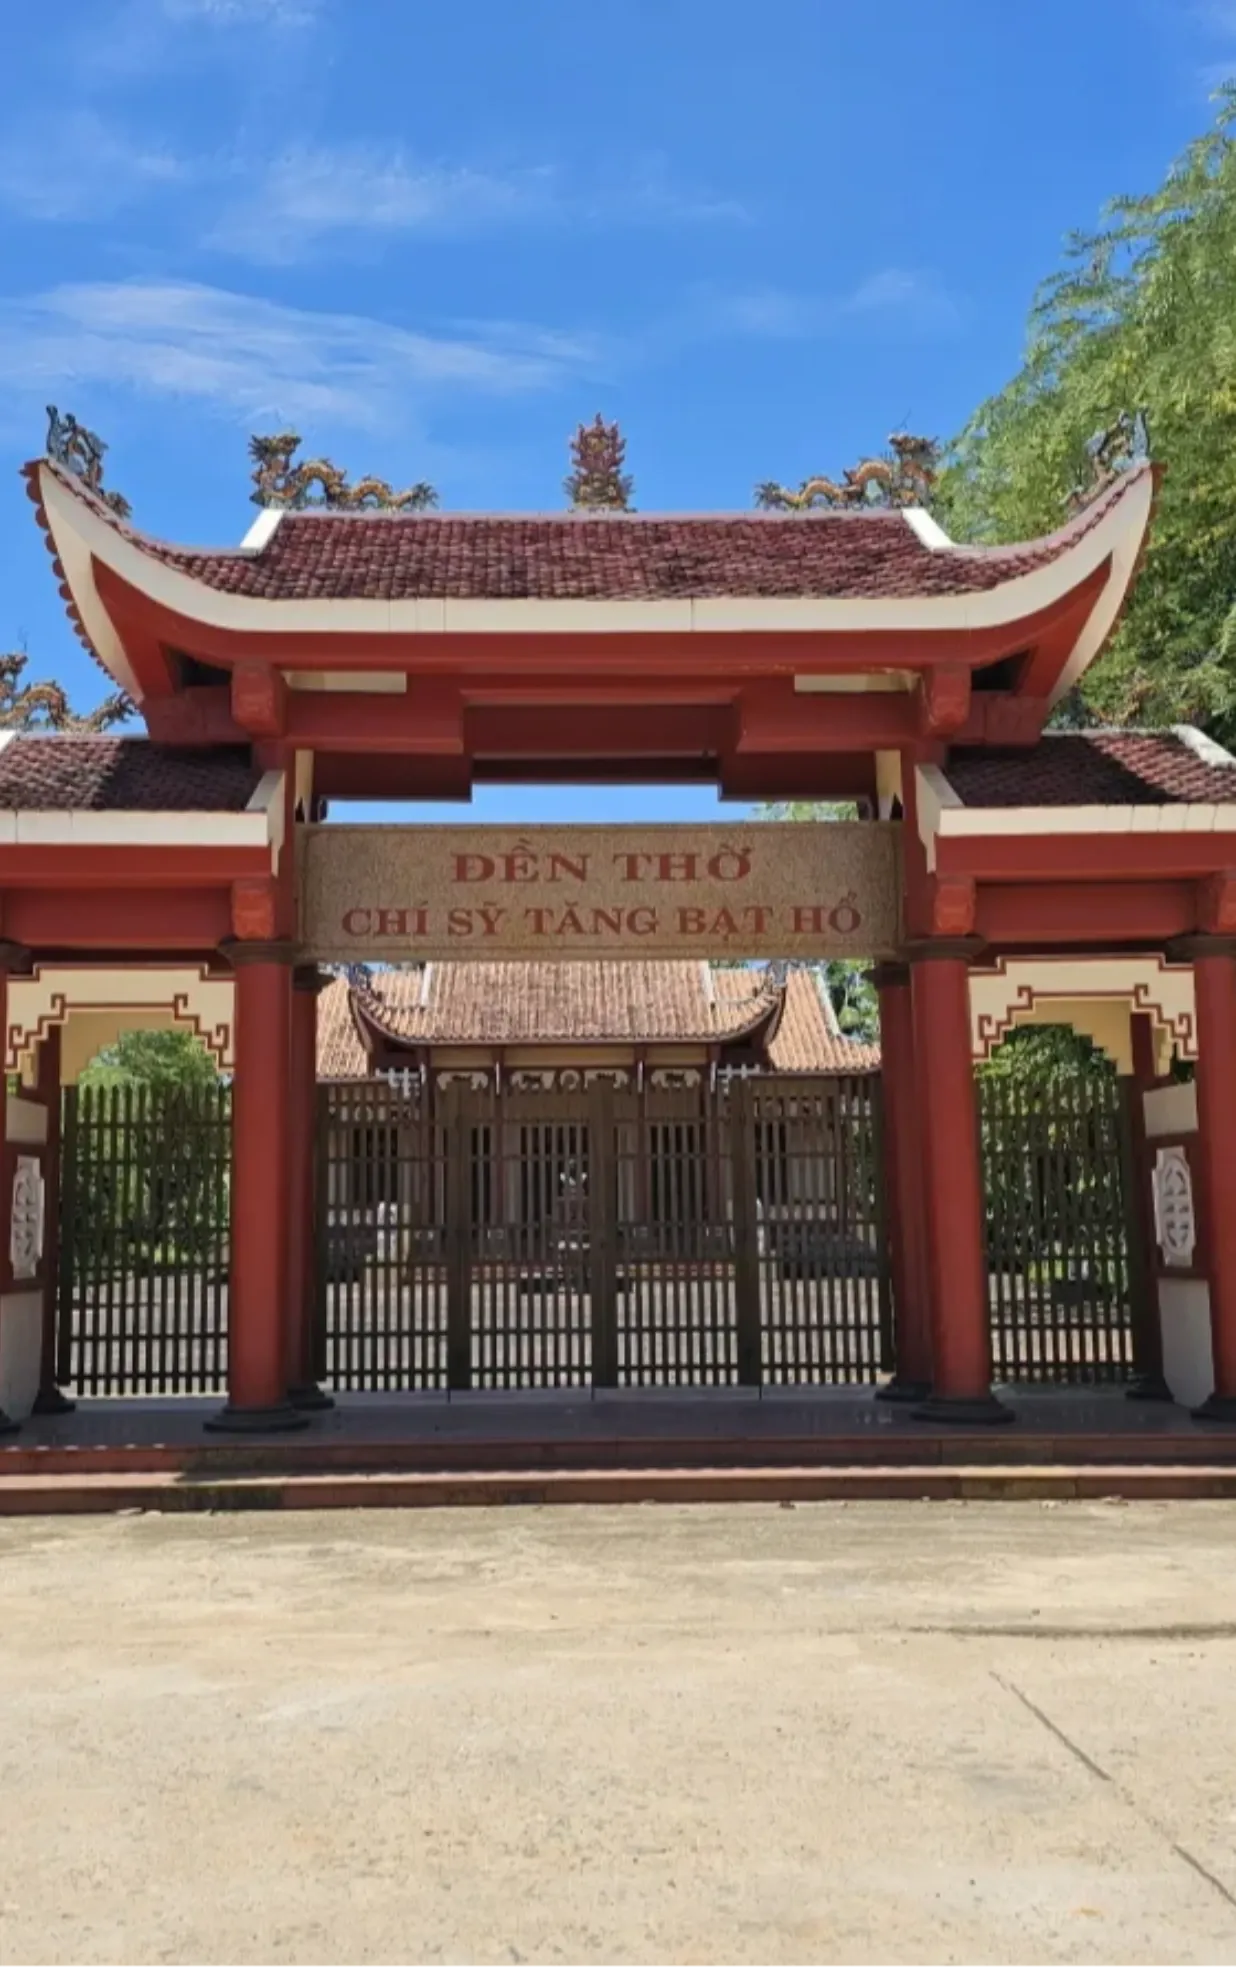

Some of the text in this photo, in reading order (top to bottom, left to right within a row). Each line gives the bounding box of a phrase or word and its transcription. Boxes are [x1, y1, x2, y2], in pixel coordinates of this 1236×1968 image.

[451, 838, 754, 883] ĐỀN THỜ
[342, 891, 861, 942] CHÍ SỸ TĂNG BẠT HỔ
